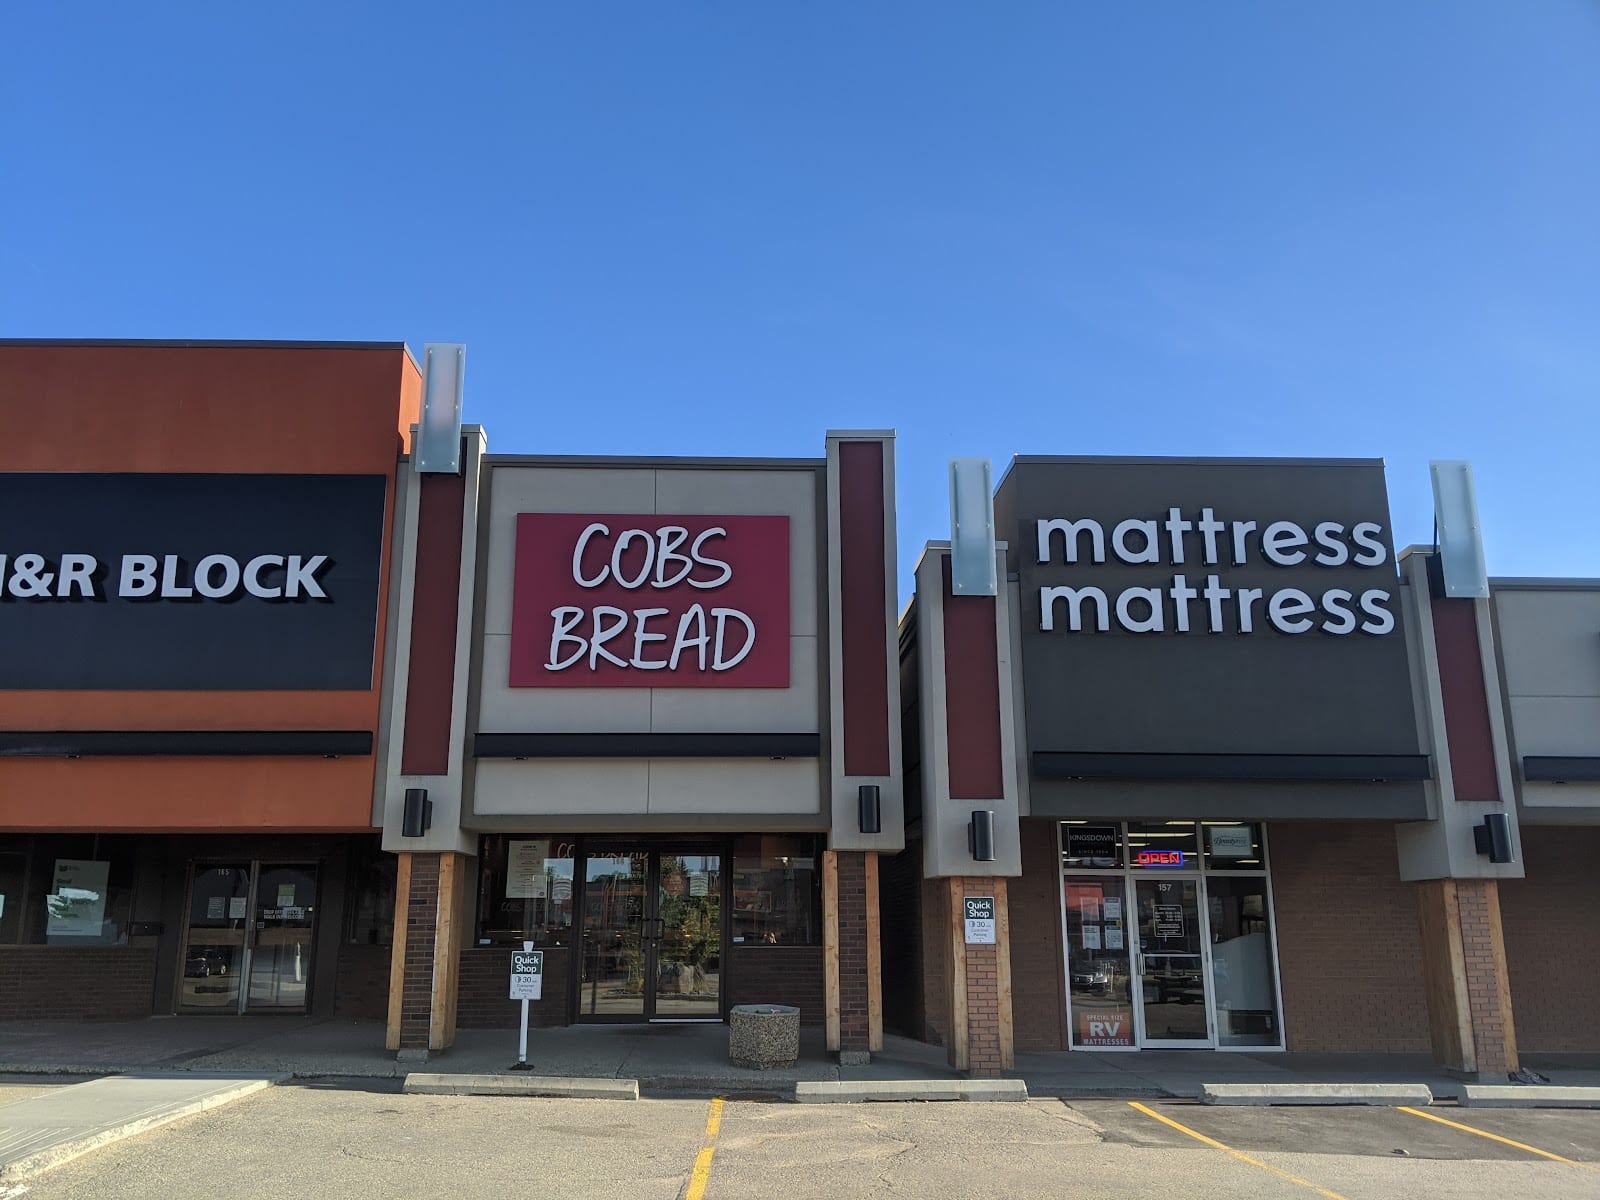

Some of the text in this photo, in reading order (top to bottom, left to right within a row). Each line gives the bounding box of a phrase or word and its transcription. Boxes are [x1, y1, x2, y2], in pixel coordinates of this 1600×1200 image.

[1036, 507, 1388, 566] mattress
[572, 523, 733, 589] COBS
[0, 553, 329, 598] &R BLOCK
[1039, 574, 1396, 635] mattress
[544, 603, 756, 671] BREAD
[1138, 853, 1180, 864] OPEN
[1158, 884, 1172, 892] 157
[967, 901, 991, 910] Quick
[969, 909, 990, 918] Shop
[515, 955, 539, 964] Quick
[516, 964, 537, 973] Shop
[1090, 1022, 1120, 1037] RV
